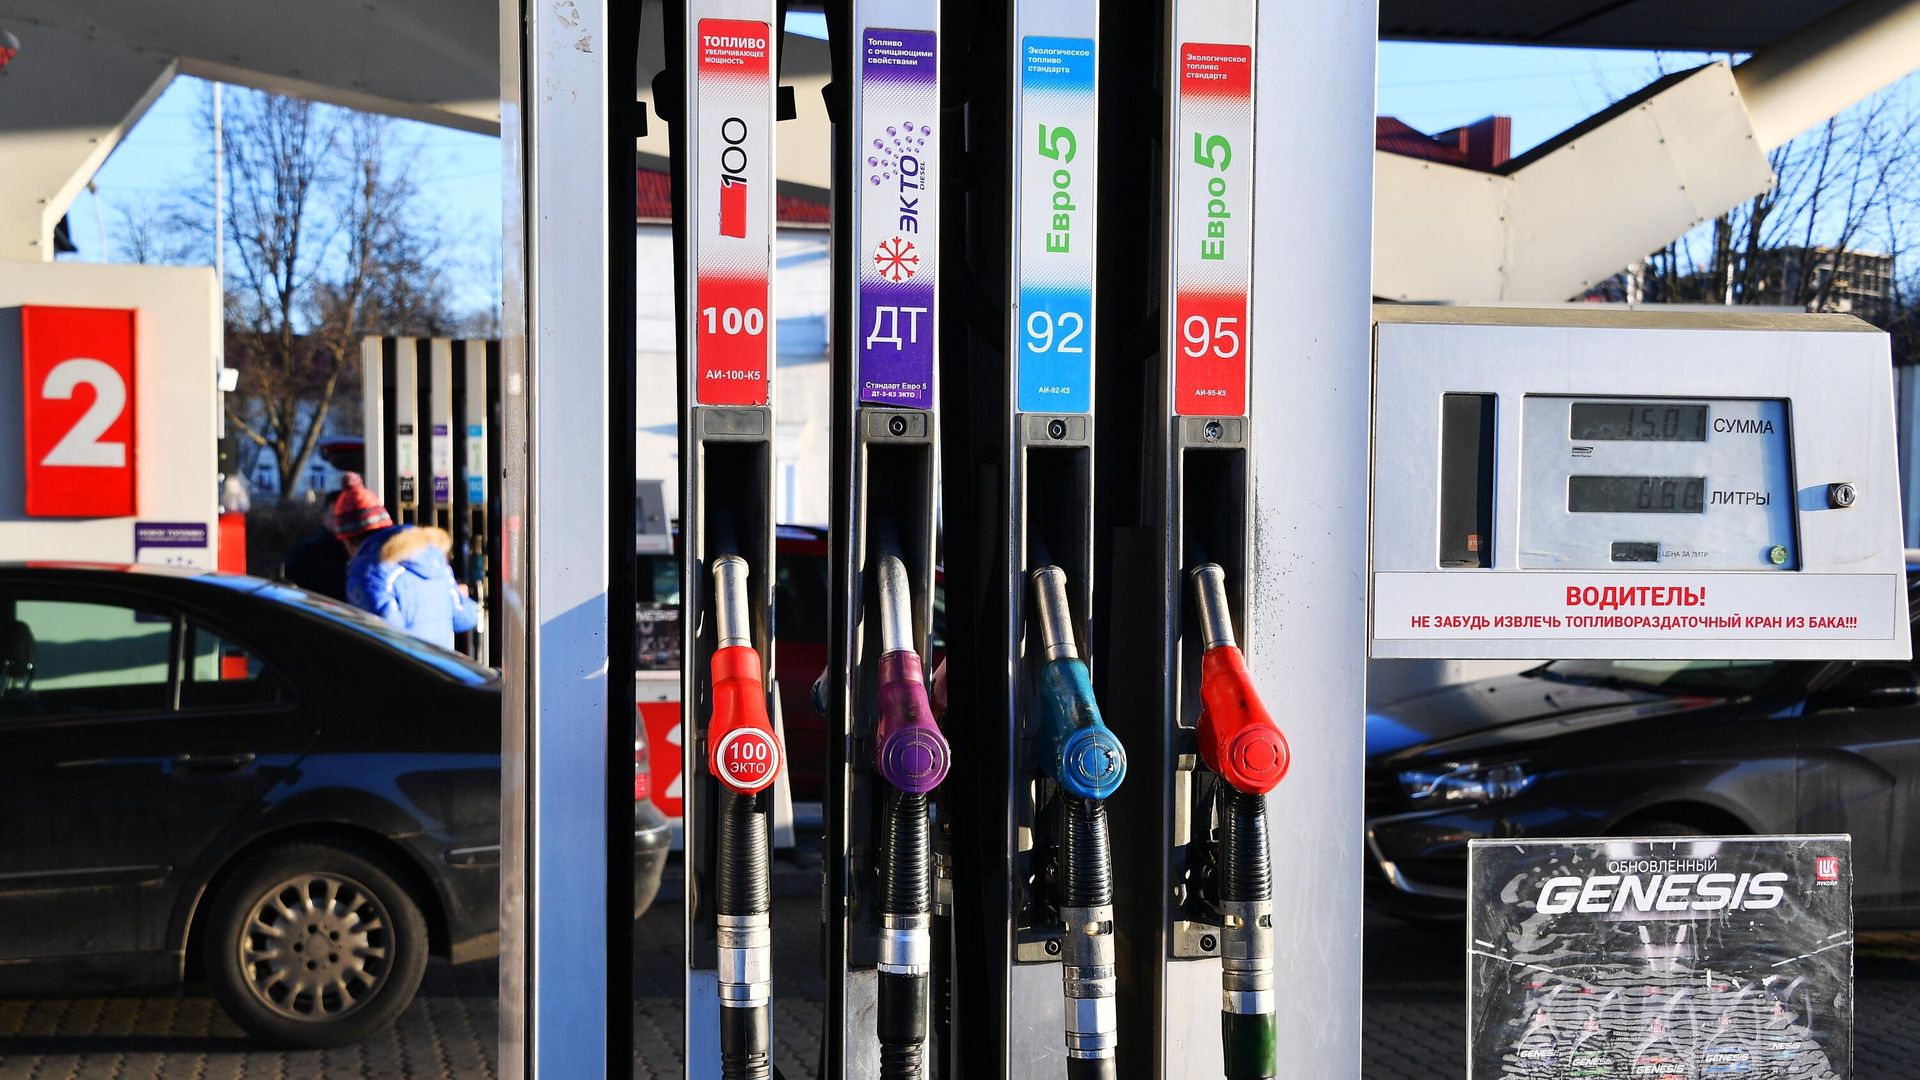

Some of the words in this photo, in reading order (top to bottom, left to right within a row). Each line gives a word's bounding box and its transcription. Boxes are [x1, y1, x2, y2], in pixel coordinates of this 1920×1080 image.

[703, 35, 766, 49] ТОПЛИВО
[868, 38, 903, 47] Топливо
[704, 49, 765, 58] УВЕЛИЧИВАЮЩЕЕ
[874, 48, 933, 58] очищающими
[1028, 46, 1090, 57] Экологическое
[704, 57, 745, 65] МОЩНОСТЬ
[867, 56, 918, 66] свойствами
[1028, 56, 1062, 64] топливо
[1186, 53, 1247, 63] Экологическое
[1028, 65, 1070, 74] стандарта
[1186, 63, 1219, 71] топливо
[1186, 72, 1227, 80] стандарта
[721, 117, 747, 186] 100
[899, 155, 919, 234] ЭКТО
[703, 307, 764, 335] 100
[866, 306, 927, 351] ДТ
[1027, 311, 1083, 353] 92
[1183, 315, 1239, 358] 95
[705, 370, 760, 381] АИ-100-К5
[865, 381, 900, 390] Стандарт
[901, 382, 921, 392] Евро
[1038, 386, 1071, 395] АИ-92-К5
[898, 390, 915, 398] ЭКТО
[1195, 389, 1227, 397] АИ-95-К5
[40, 357, 126, 467] 2
[1713, 418, 1774, 434] СУММА
[1710, 491, 1770, 506] ЛИТРЫ
[1662, 550, 1680, 558] ЦЕНА
[1681, 550, 1690, 558] ЗА
[1566, 586, 1706, 610] ВОДИТЕЛЬ!
[1411, 615, 1430, 628] НЕ
[1434, 615, 1490, 630] ЗАБУДЬ
[1494, 615, 1561, 628] ИЗВЛЕЧЬ
[1565, 613, 1741, 630] ТОПЛИВОРАЗДАТОЧНЫЙ
[1745, 616, 1780, 628] КРАН
[1786, 616, 1805, 628] ИЗ
[1808, 616, 1858, 628] БАКА!!!
[730, 742, 767, 760] 100
[730, 762, 766, 774] ЭКТО
[1608, 857, 1718, 874] ОБНОВЛЕННЫЙ
[1536, 872, 1788, 915] GENESIS
[1705, 1054, 1749, 1062] GENESIS
[1636, 1065, 1684, 1074] GENESIS
